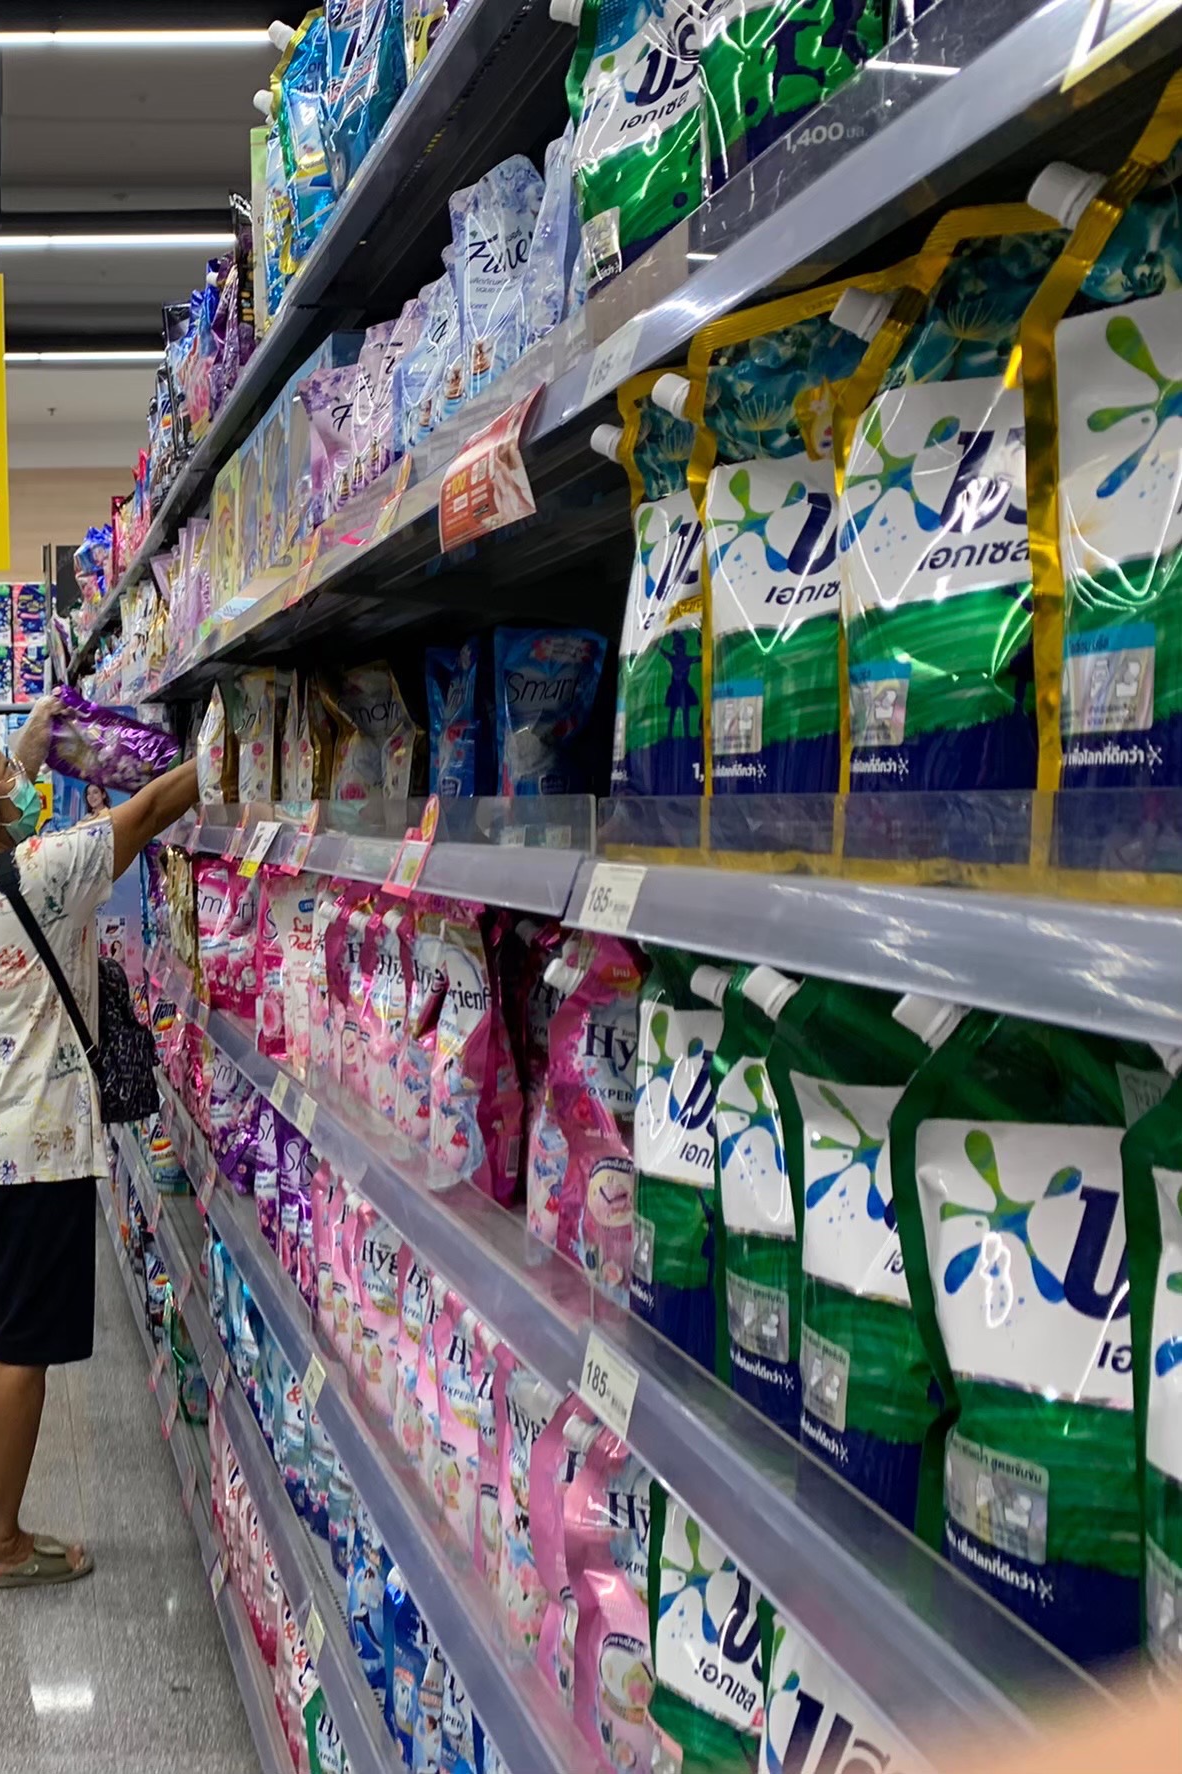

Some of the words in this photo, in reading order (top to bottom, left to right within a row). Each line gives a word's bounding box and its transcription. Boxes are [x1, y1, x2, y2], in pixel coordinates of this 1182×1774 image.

[784, 123, 845, 152] 1,400
[507, 672, 580, 704] Smart
[588, 886, 612, 913] 185
[587, 1360, 608, 1398] 185
